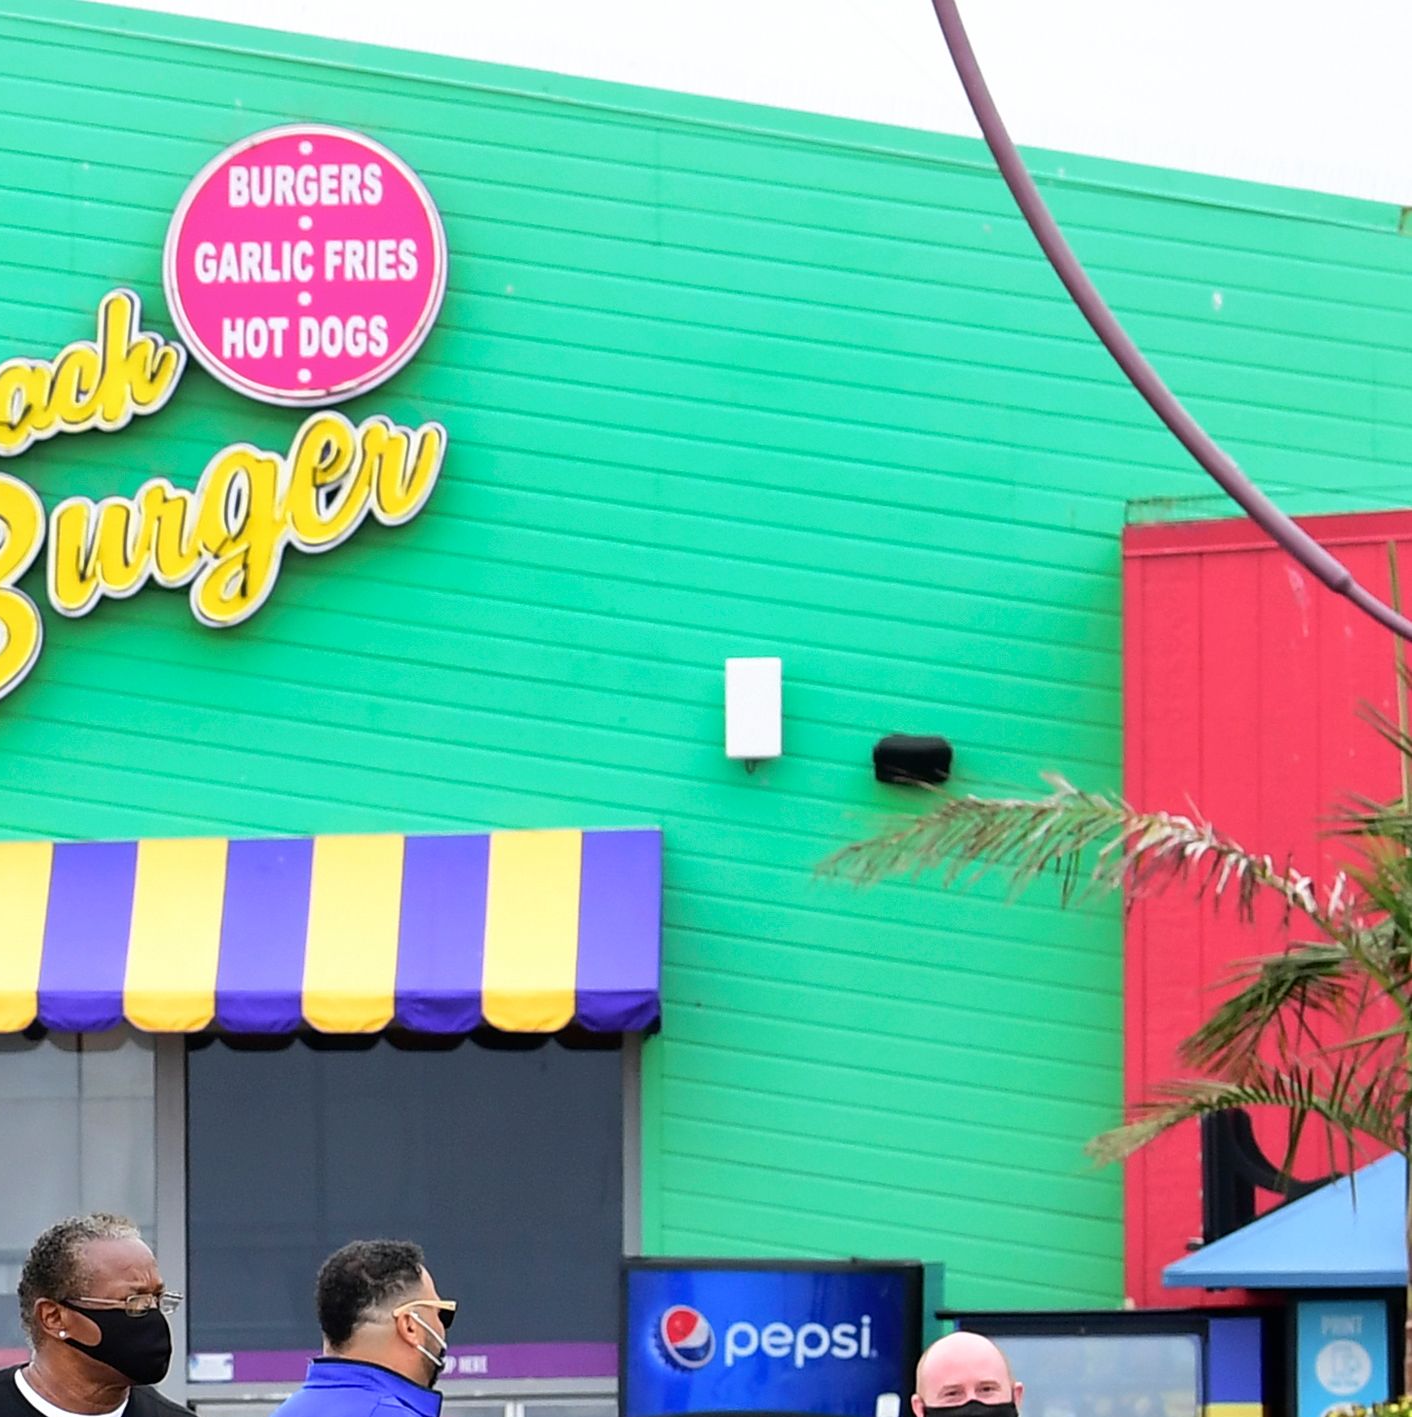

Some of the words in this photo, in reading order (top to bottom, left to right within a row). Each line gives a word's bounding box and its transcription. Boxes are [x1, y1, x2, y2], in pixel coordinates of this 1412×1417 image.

[229, 163, 383, 207] BURGERS
[194, 240, 315, 283] GARLIC
[324, 239, 419, 281] FRIES
[222, 316, 289, 359] HOT
[299, 314, 389, 358] DOGS
[724, 1315, 872, 1368] pepsi
[1321, 1315, 1363, 1335] PRINT
[458, 1355, 488, 1374] HERE
